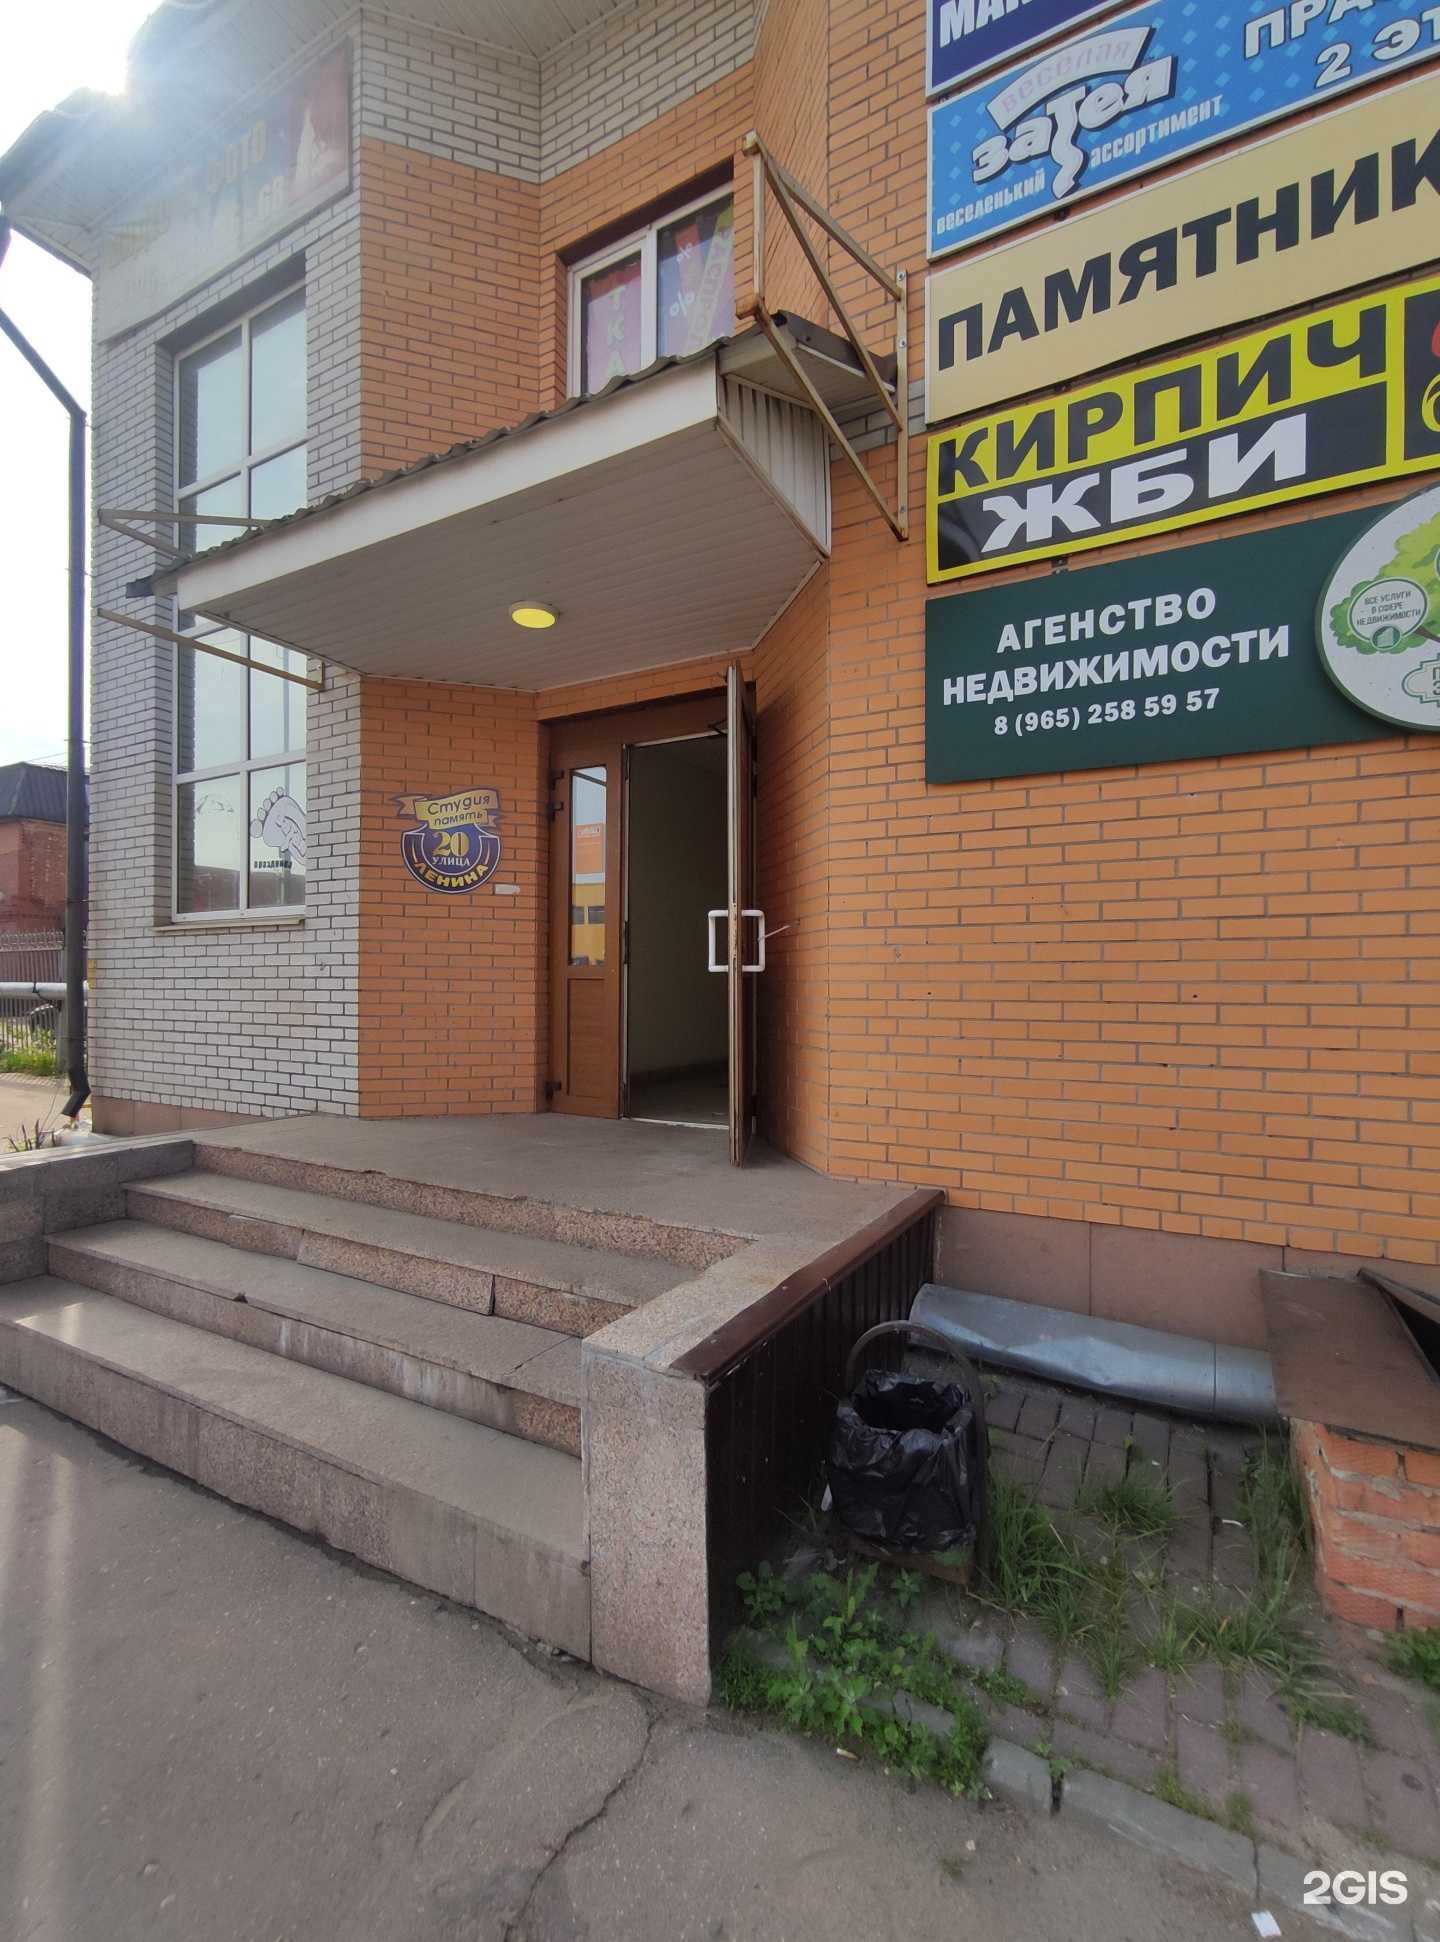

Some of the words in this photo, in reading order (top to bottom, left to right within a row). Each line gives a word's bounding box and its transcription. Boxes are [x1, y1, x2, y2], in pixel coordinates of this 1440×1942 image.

[1314, 43, 1351, 88] 2
[936, 168, 1046, 235] веселенький
[1090, 94, 1223, 168] ассортимент
[938, 127, 1440, 372] ПАМЯТНИК
[938, 303, 1388, 497] КИРПИЧ
[981, 413, 1307, 553] ЖБИ
[996, 587, 1217, 653] АГЕНСТВО
[1356, 608, 1421, 626] НЕДВИЖИМОСТИ
[943, 624, 1290, 706] НЕДВИЖИМОСТИ
[994, 715, 1009, 736] 8
[1015, 706, 1080, 737] (965)
[1087, 699, 1137, 725] 258
[1144, 693, 1178, 718] 59
[1185, 687, 1221, 712] 57
[427, 795, 491, 816] Студия
[434, 811, 483, 826] память
[431, 831, 470, 857] 20
[431, 856, 471, 867] УЛИЦА
[414, 863, 489, 888] ЛЕНИНА
